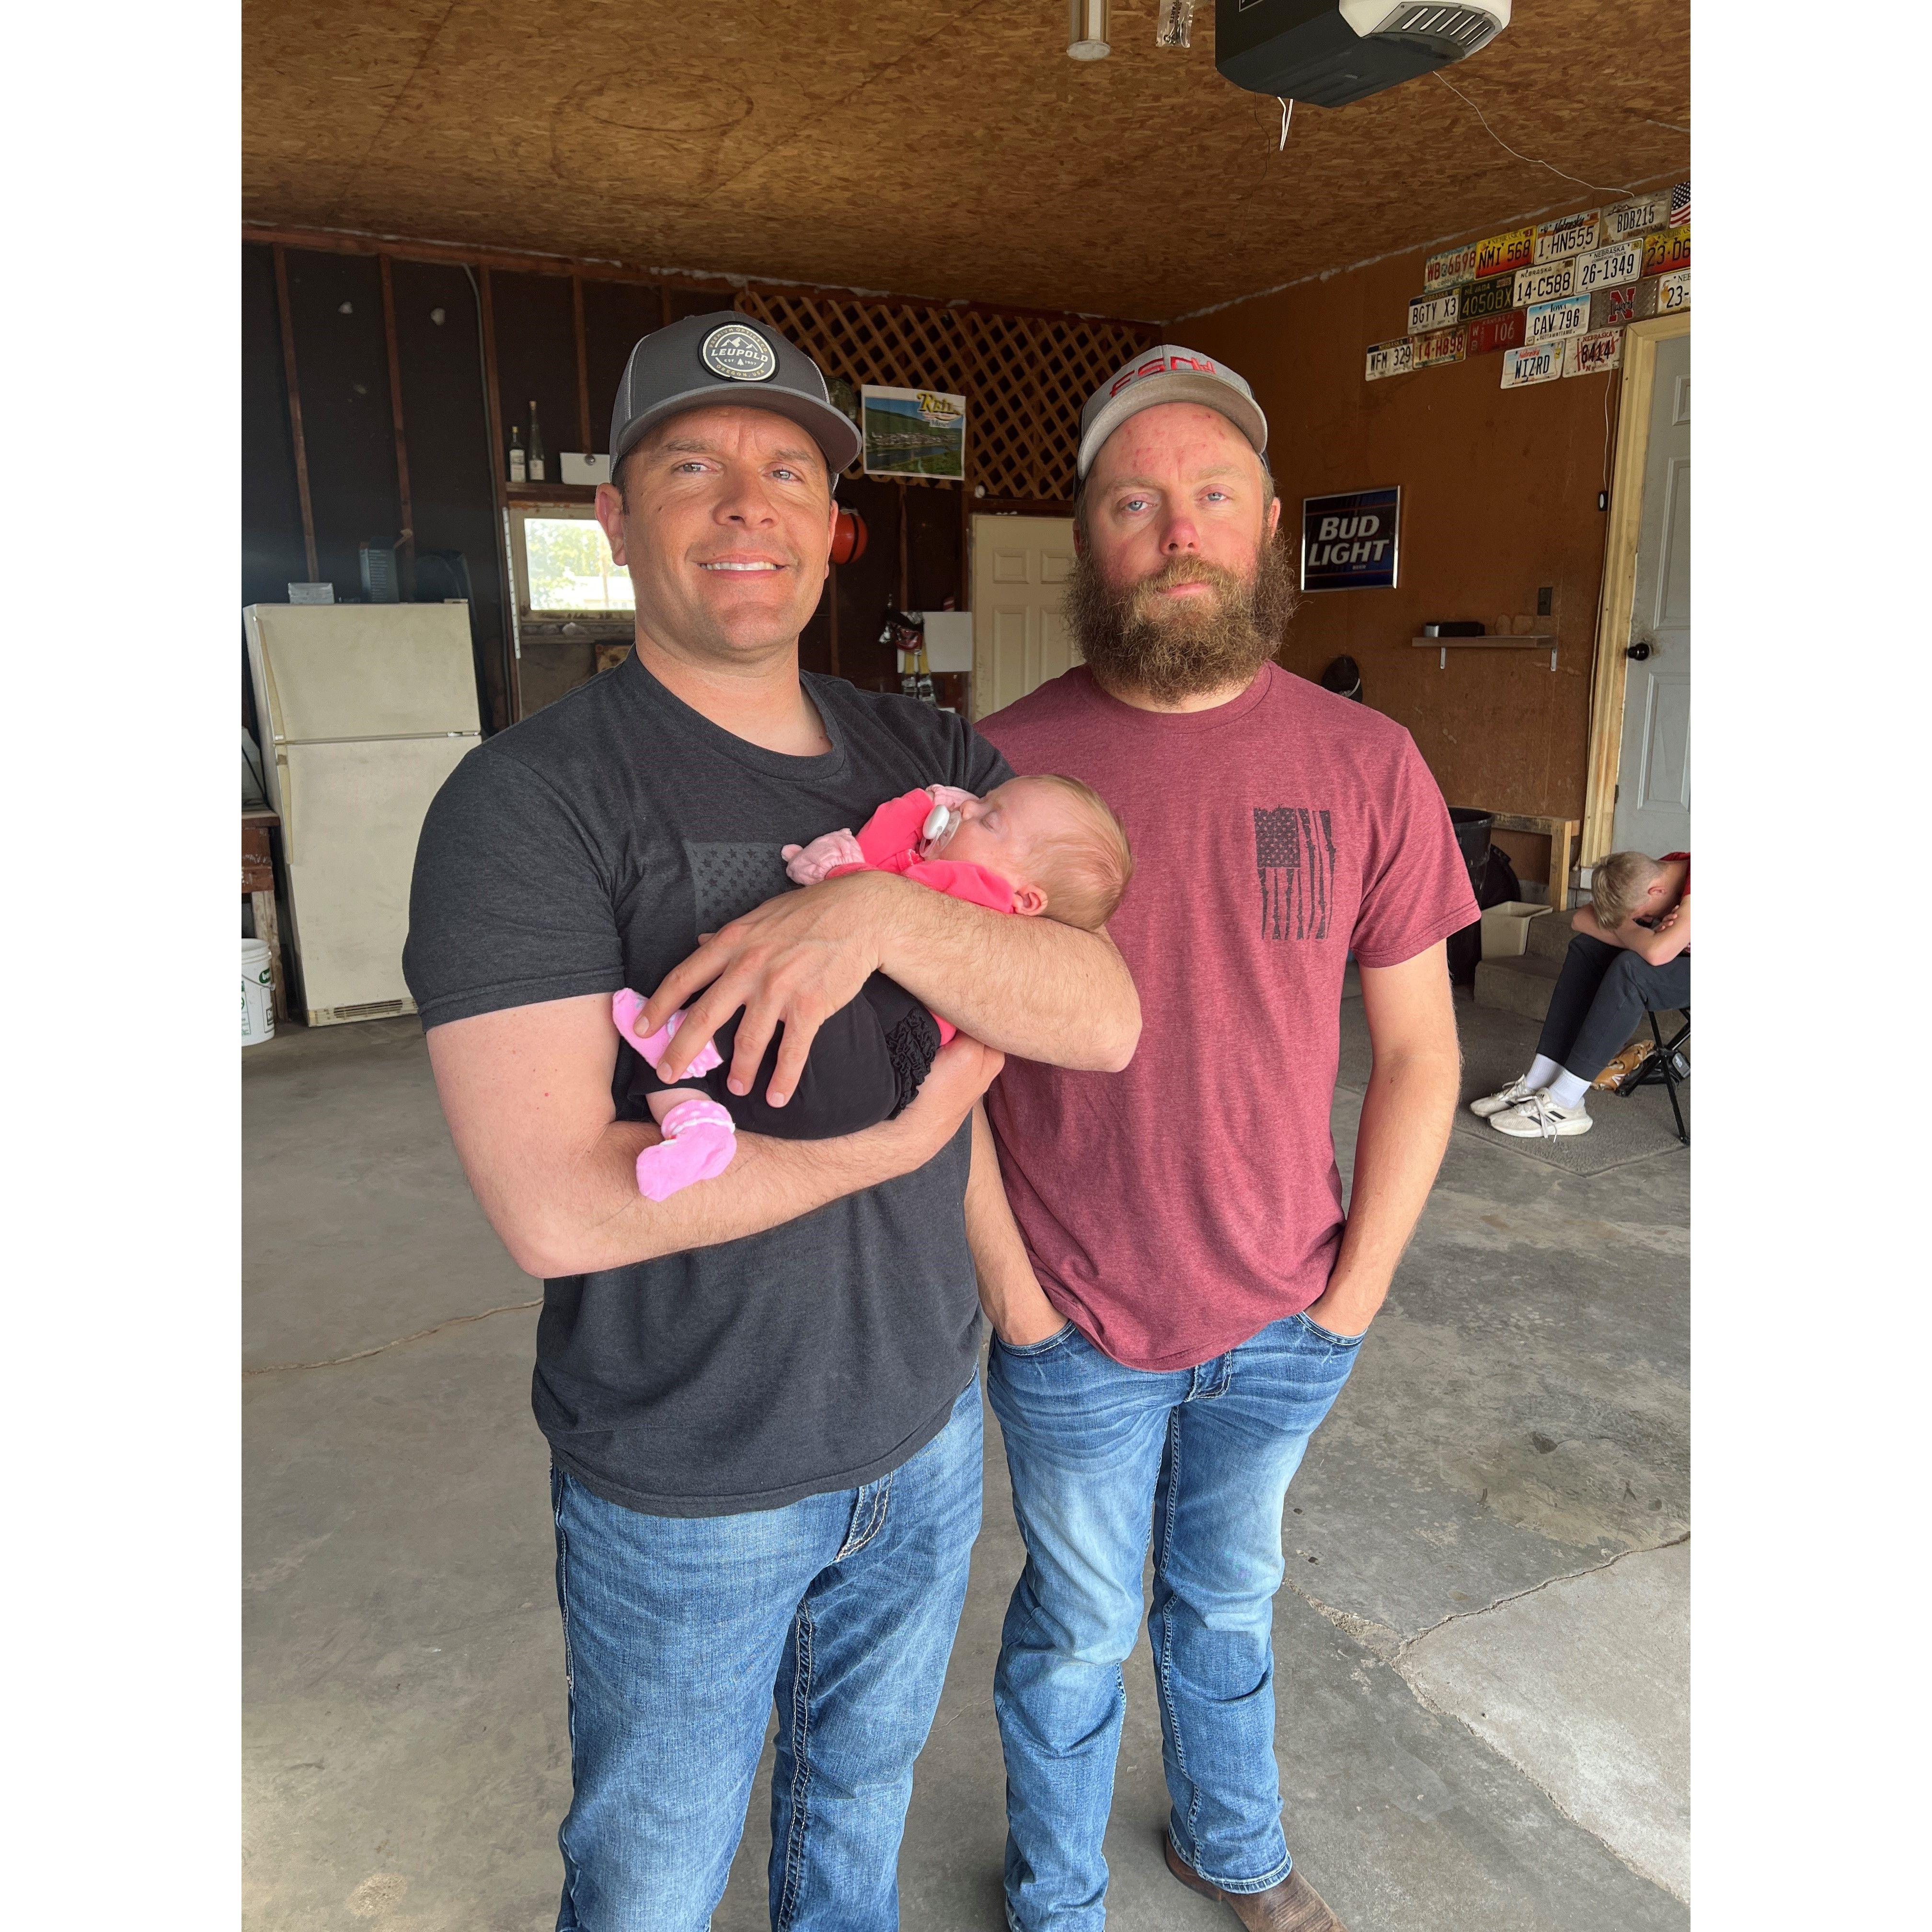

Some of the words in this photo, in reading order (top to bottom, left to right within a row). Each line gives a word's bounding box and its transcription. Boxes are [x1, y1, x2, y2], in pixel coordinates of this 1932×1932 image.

[1617, 204, 1655, 233] BDB215
[1507, 239, 1531, 262] 568
[1594, 245, 1625, 258] NEBRASKA
[1520, 266, 1552, 278] NEBRASKA
[1581, 253, 1634, 286] 26-1349
[1412, 301, 1437, 325] BGTY
[1444, 297, 1456, 318] X3
[1533, 313, 1556, 335] CAV
[1559, 308, 1580, 330] 796
[709, 328, 734, 348] PREMIUM
[736, 328, 760, 343] OPTICS
[1495, 321, 1515, 342] 106
[1583, 331, 1613, 342] NEBRASKA
[711, 348, 769, 362] LEUPOLD
[1393, 345, 1411, 366] 329
[752, 369, 765, 377] USA
[1515, 355, 1550, 380] WIZRD
[1318, 515, 1380, 541] BUD
[1308, 538, 1390, 567] LIGHT
